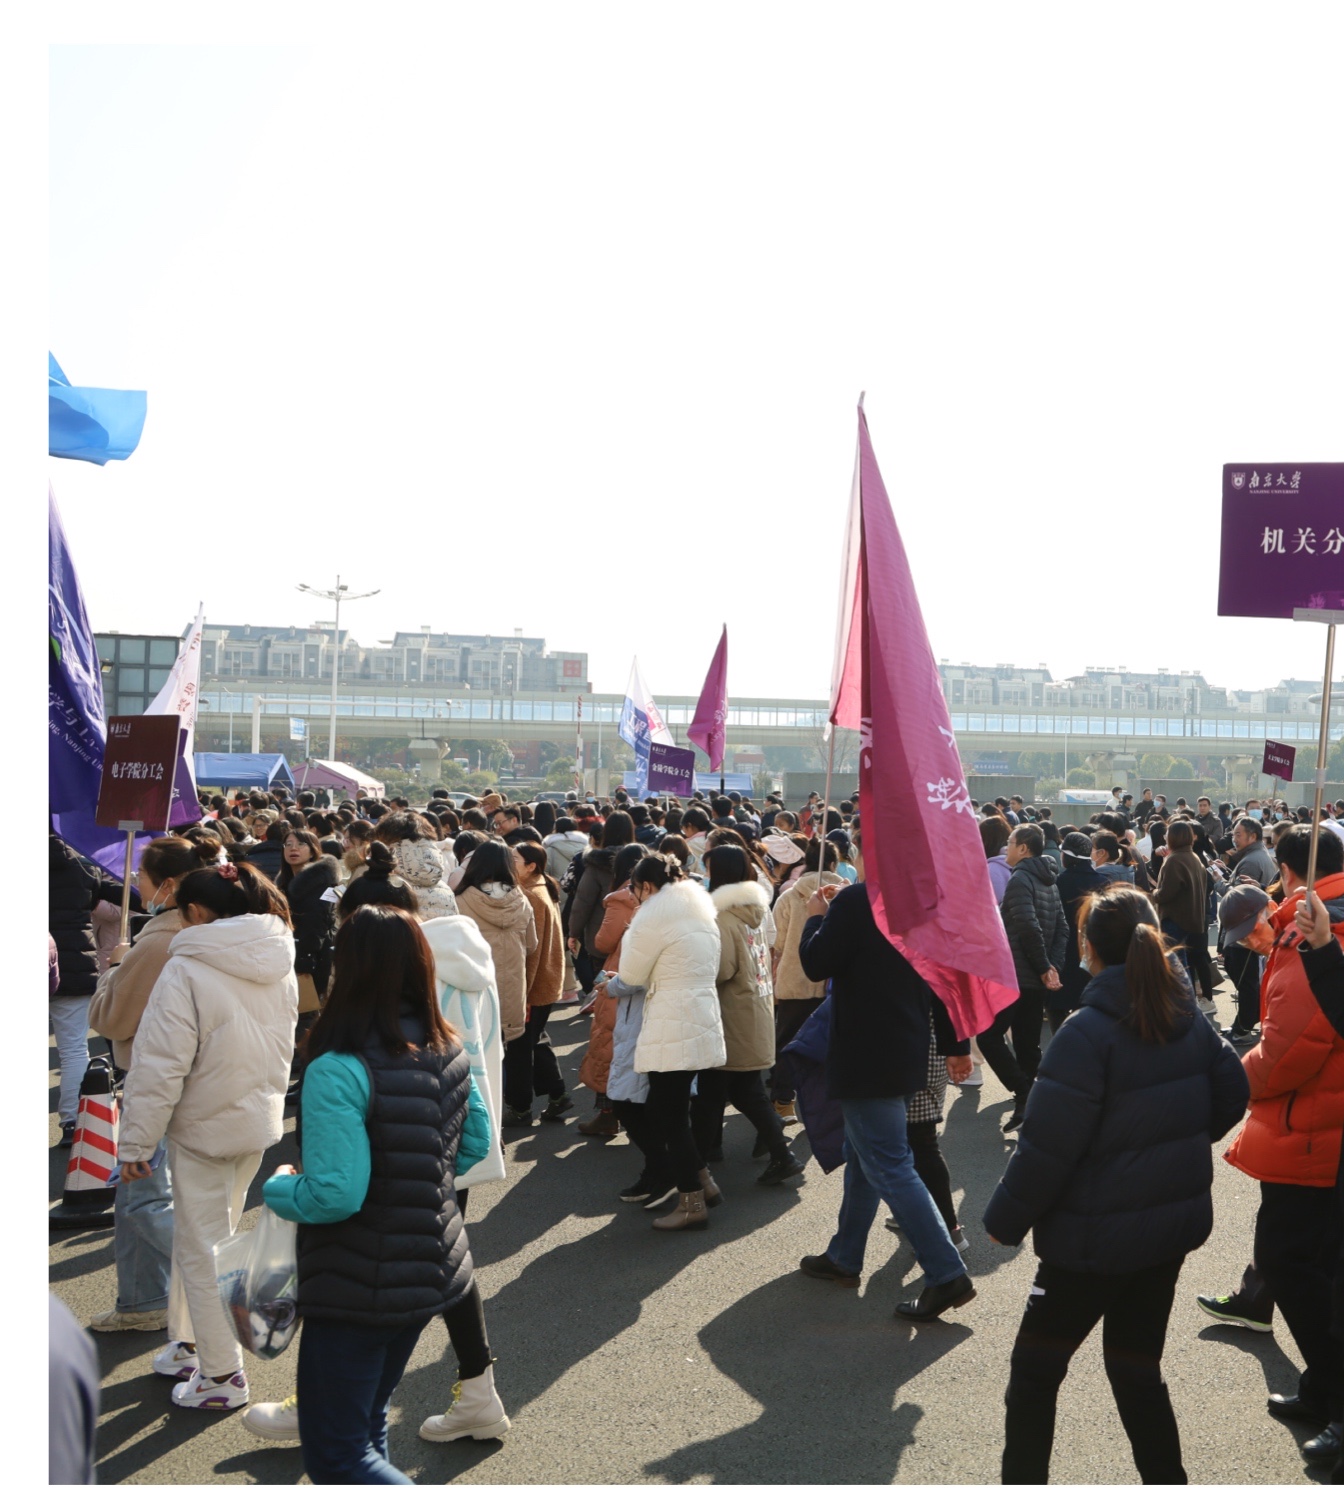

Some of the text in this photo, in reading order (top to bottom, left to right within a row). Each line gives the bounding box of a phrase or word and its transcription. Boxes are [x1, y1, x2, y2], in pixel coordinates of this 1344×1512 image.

[1249, 470, 1301, 489] 南京大学
[111, 761, 164, 780] 电子学院分工会
[652, 763, 690, 777] 金陵学院分工会
